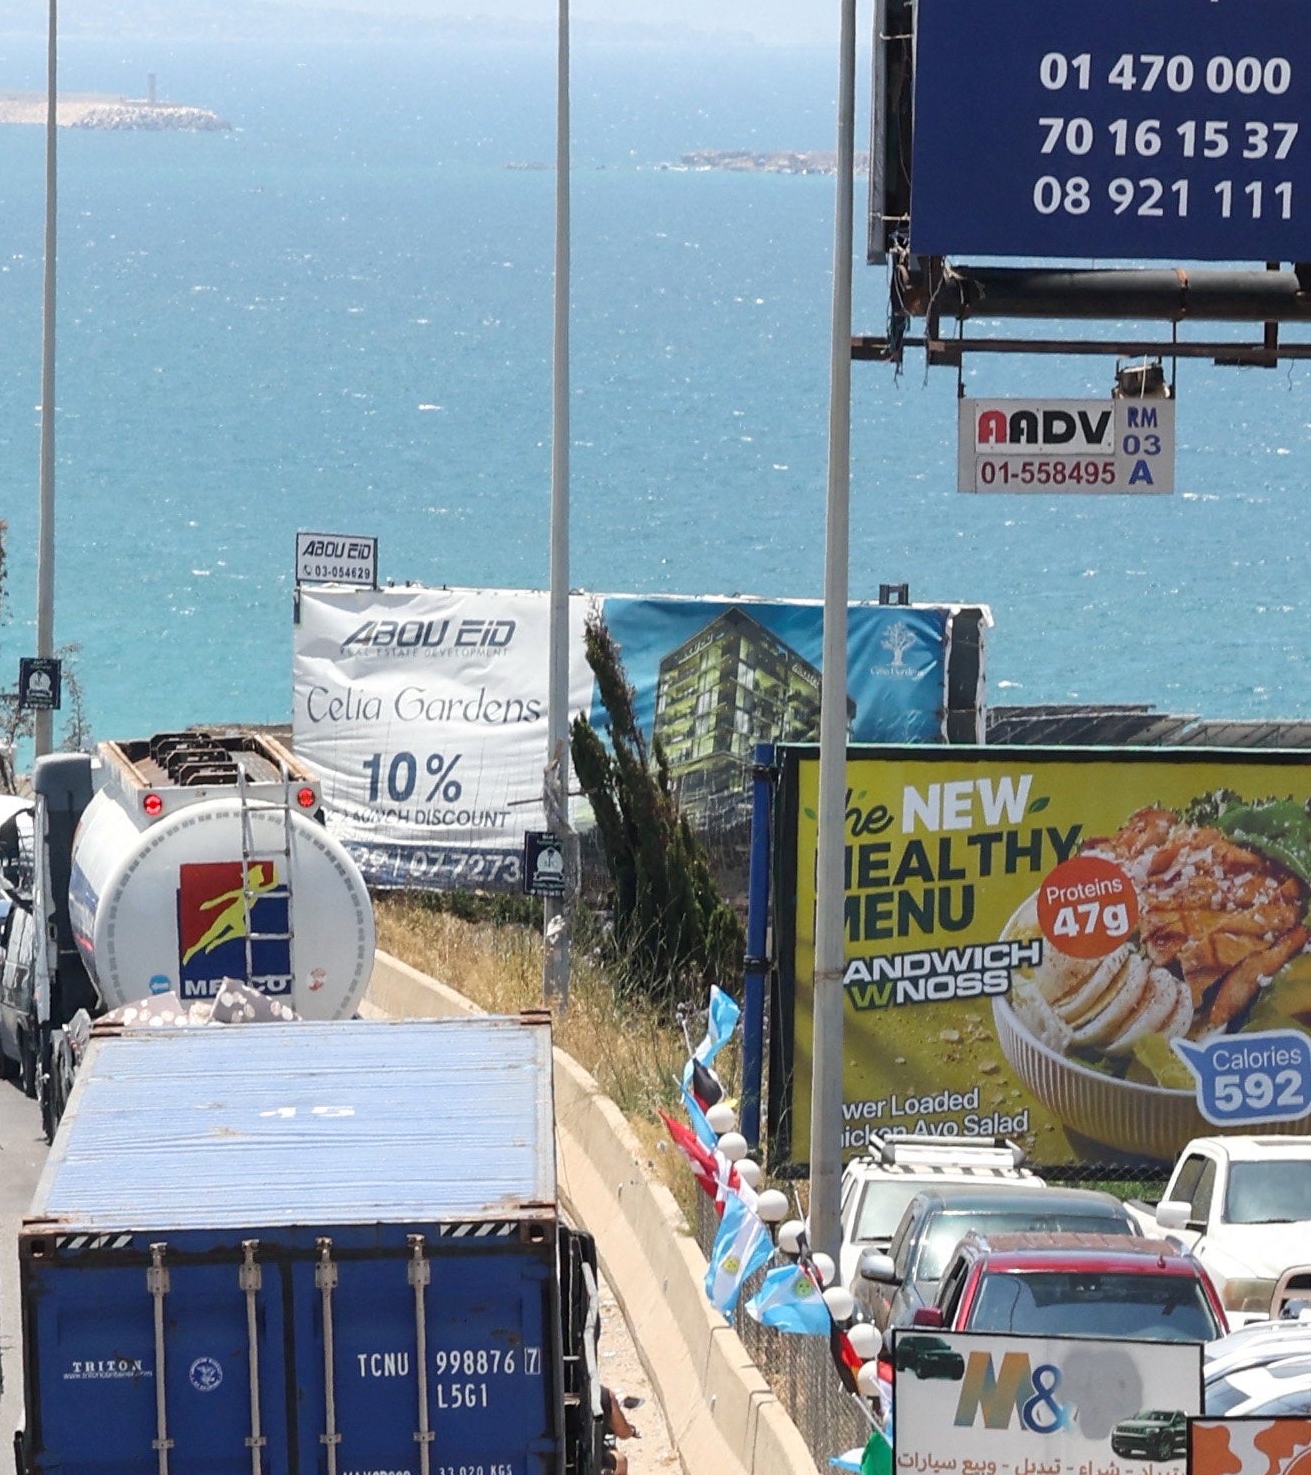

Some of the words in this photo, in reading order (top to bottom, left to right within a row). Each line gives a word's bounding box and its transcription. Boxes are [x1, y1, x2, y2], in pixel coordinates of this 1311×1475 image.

[1039, 53, 1091, 91] 01
[1108, 54, 1194, 92] 470
[1206, 56, 1291, 94] 000
[1038, 117, 1093, 155] 70
[1108, 118, 1162, 156] 16
[1177, 120, 1228, 158] 15
[1243, 121, 1298, 159] 37
[1033, 175, 1091, 215] 08
[1108, 177, 1189, 217] 921
[1215, 180, 1292, 219] 111
[978, 409, 1112, 444] AADV
[1128, 406, 1158, 428] RM
[1122, 434, 1161, 456] 03
[981, 460, 1116, 485] 01-558495
[1128, 459, 1154, 485] A
[302, 540, 344, 558] ABOU
[315, 564, 371, 580] 03-054629
[342, 619, 448, 647] ABOU
[307, 685, 381, 724] Celia
[395, 685, 541, 725] Gardens
[363, 751, 463, 804] 10%
[414, 808, 512, 828] DISCOUNT
[902, 774, 1033, 834] NEW
[1046, 876, 1123, 904] Proteins
[1053, 901, 1129, 937] 47g
[844, 940, 1041, 985] ANDWICH
[1213, 1045, 1302, 1071] Calories
[891, 1087, 979, 1118] Loaded
[1214, 1069, 1305, 1112] 592
[963, 1111, 1029, 1136] Salad
[73, 1360, 143, 1373] TRITON
[358, 1352, 409, 1377] TCNU
[436, 1350, 515, 1375] 998876
[527, 1348, 538, 1374] 7
[437, 1383, 487, 1409] L5G1
[897, 1452, 957, 1474] سيارات
